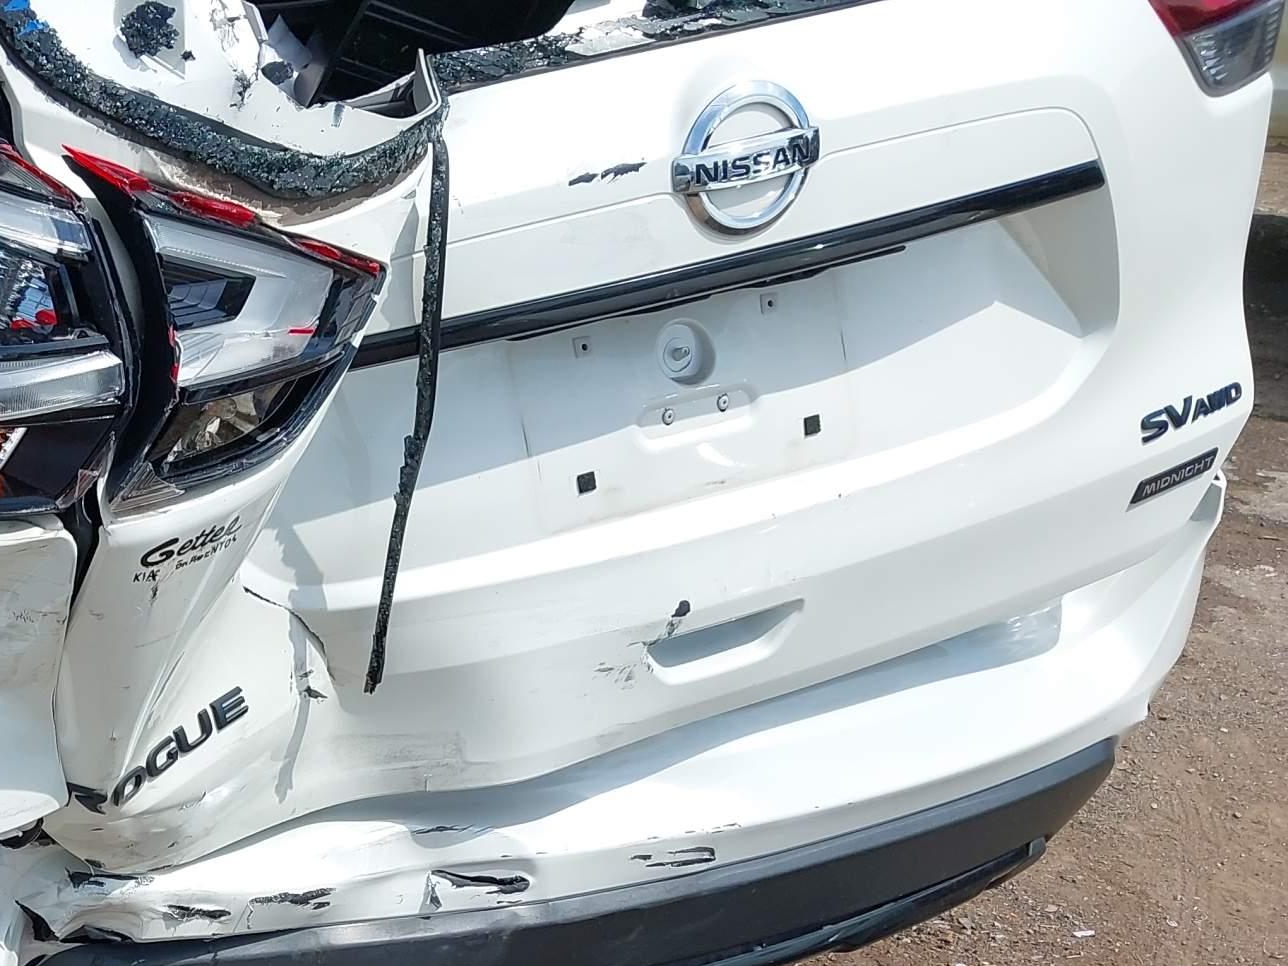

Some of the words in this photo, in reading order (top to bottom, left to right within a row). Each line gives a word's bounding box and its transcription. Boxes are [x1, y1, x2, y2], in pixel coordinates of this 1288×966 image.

[695, 142, 810, 185] NISSAN
[1140, 395, 1193, 445] SV
[1191, 382, 1243, 424] AWD
[1142, 455, 1215, 497] MIDNIGHT
